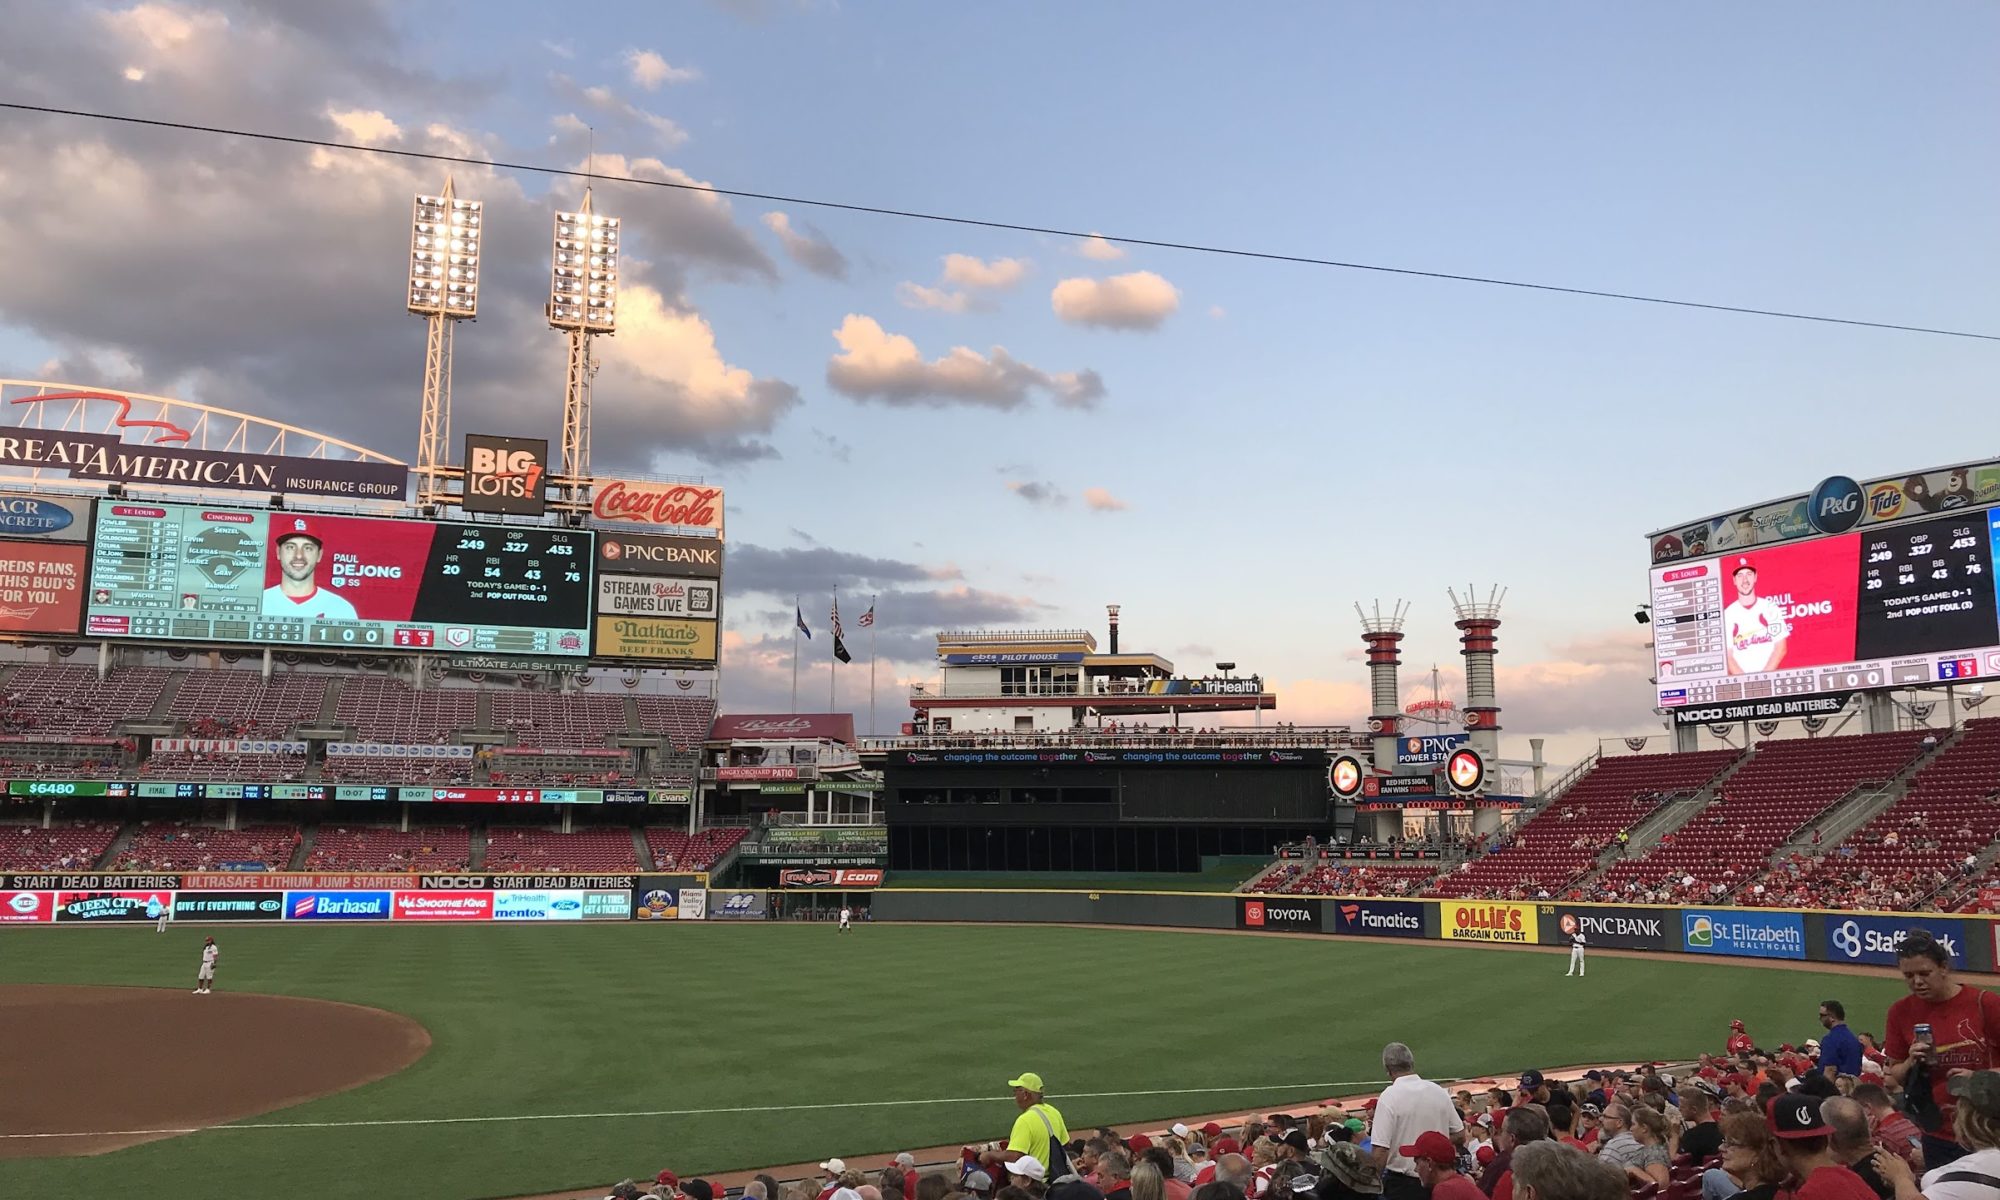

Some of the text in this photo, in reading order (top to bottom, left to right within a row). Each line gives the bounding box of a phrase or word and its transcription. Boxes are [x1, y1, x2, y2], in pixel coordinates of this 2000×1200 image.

[472, 447, 536, 474] BIG
[78, 446, 276, 487] AMERICAN
[286, 477, 354, 493] INSURANCE
[358, 482, 398, 495] GROUP
[593, 481, 721, 526] Coca-Cola
[1820, 492, 1858, 517] P&G
[1870, 491, 1901, 516] Tide
[207, 514, 249, 522] CINCINNATI
[1752, 513, 1786, 529] Swiffer
[214, 526, 240, 535] SENZEL
[1780, 522, 1809, 533] Pampers
[1871, 528, 1970, 550] AVG OBP SLG
[189, 547, 219, 555] IGLESIAS
[456, 539, 573, 556] .249 .327 .453
[1868, 537, 1976, 563] .249 .327 .453
[333, 553, 359, 563] PAUL
[446, 554, 459, 562] HR
[486, 557, 500, 565] RBI
[0, 560, 77, 577] REDS FANS,
[332, 563, 401, 578] DEJONG
[1868, 554, 1976, 578] HR RBI BB R
[442, 564, 581, 582] 20 54 43 76
[1866, 564, 1981, 590] 20 54 43 76
[0, 575, 75, 591] THIS BUD'S
[467, 580, 529, 591] TODAY'S GAME:
[603, 581, 685, 598] STREAM Reds
[27, 592, 59, 604] YOU.
[691, 589, 710, 599] FOX
[1765, 593, 1795, 606] PAUL
[1883, 591, 1951, 607] TODAY'S GAME:
[614, 596, 682, 613] GAMES LIVE
[691, 599, 709, 609] GO
[1886, 609, 1902, 619] 2nd
[1905, 607, 1921, 617] POP
[1922, 605, 1939, 615] OUT
[1939, 603, 1960, 612] FOUL
[319, 628, 378, 642] 1 0 0
[614, 620, 700, 642] Nathan's
[619, 645, 694, 656] BEEF FRANKS
[452, 659, 582, 672] ULTIMATE AIR SHUTTLE
[1203, 680, 1258, 693] TriHealth
[1826, 672, 1879, 689] 1 0 0
[1677, 699, 1840, 722] NOCO START DEAD BATTERIES.
[734, 718, 811, 732] Reds
[1422, 737, 1456, 752] PNC
[943, 753, 983, 762] changing
[1039, 753, 1077, 762] together
[1122, 753, 1164, 762] changing
[1222, 752, 1262, 762] together
[1400, 753, 1429, 762] POWER
[772, 769, 793, 777] PATIO
[29, 783, 75, 795] $6480
[616, 794, 645, 803] Ballpark
[659, 792, 686, 801] Evans
[13, 876, 179, 889] START DEAD BATTERIES.
[187, 876, 416, 889] ULTRASAFE LITHIUM JUMP STARTERS.
[422, 876, 635, 889] NOCO START DEAD BATTERIES.
[415, 897, 487, 908] SMOOTHIE KING
[511, 893, 546, 902] TriHealth
[68, 897, 143, 915] QUEEN CITY
[177, 901, 256, 911] GIVE IT EVERYTHING
[317, 897, 381, 914] Barbasol
[1541, 905, 1555, 915] 370
[82, 908, 127, 919] SAUSAGE
[495, 909, 545, 918] mentos
[1267, 908, 1311, 922] TOYOTA
[1361, 910, 1419, 929] Fanatics
[1452, 929, 1526, 941] BARGAIN OUTLET
[1713, 922, 1800, 943] St. Elizabeth
[1733, 941, 1801, 952] HEALTHCARE
[1795, 1106, 1812, 1125] C
